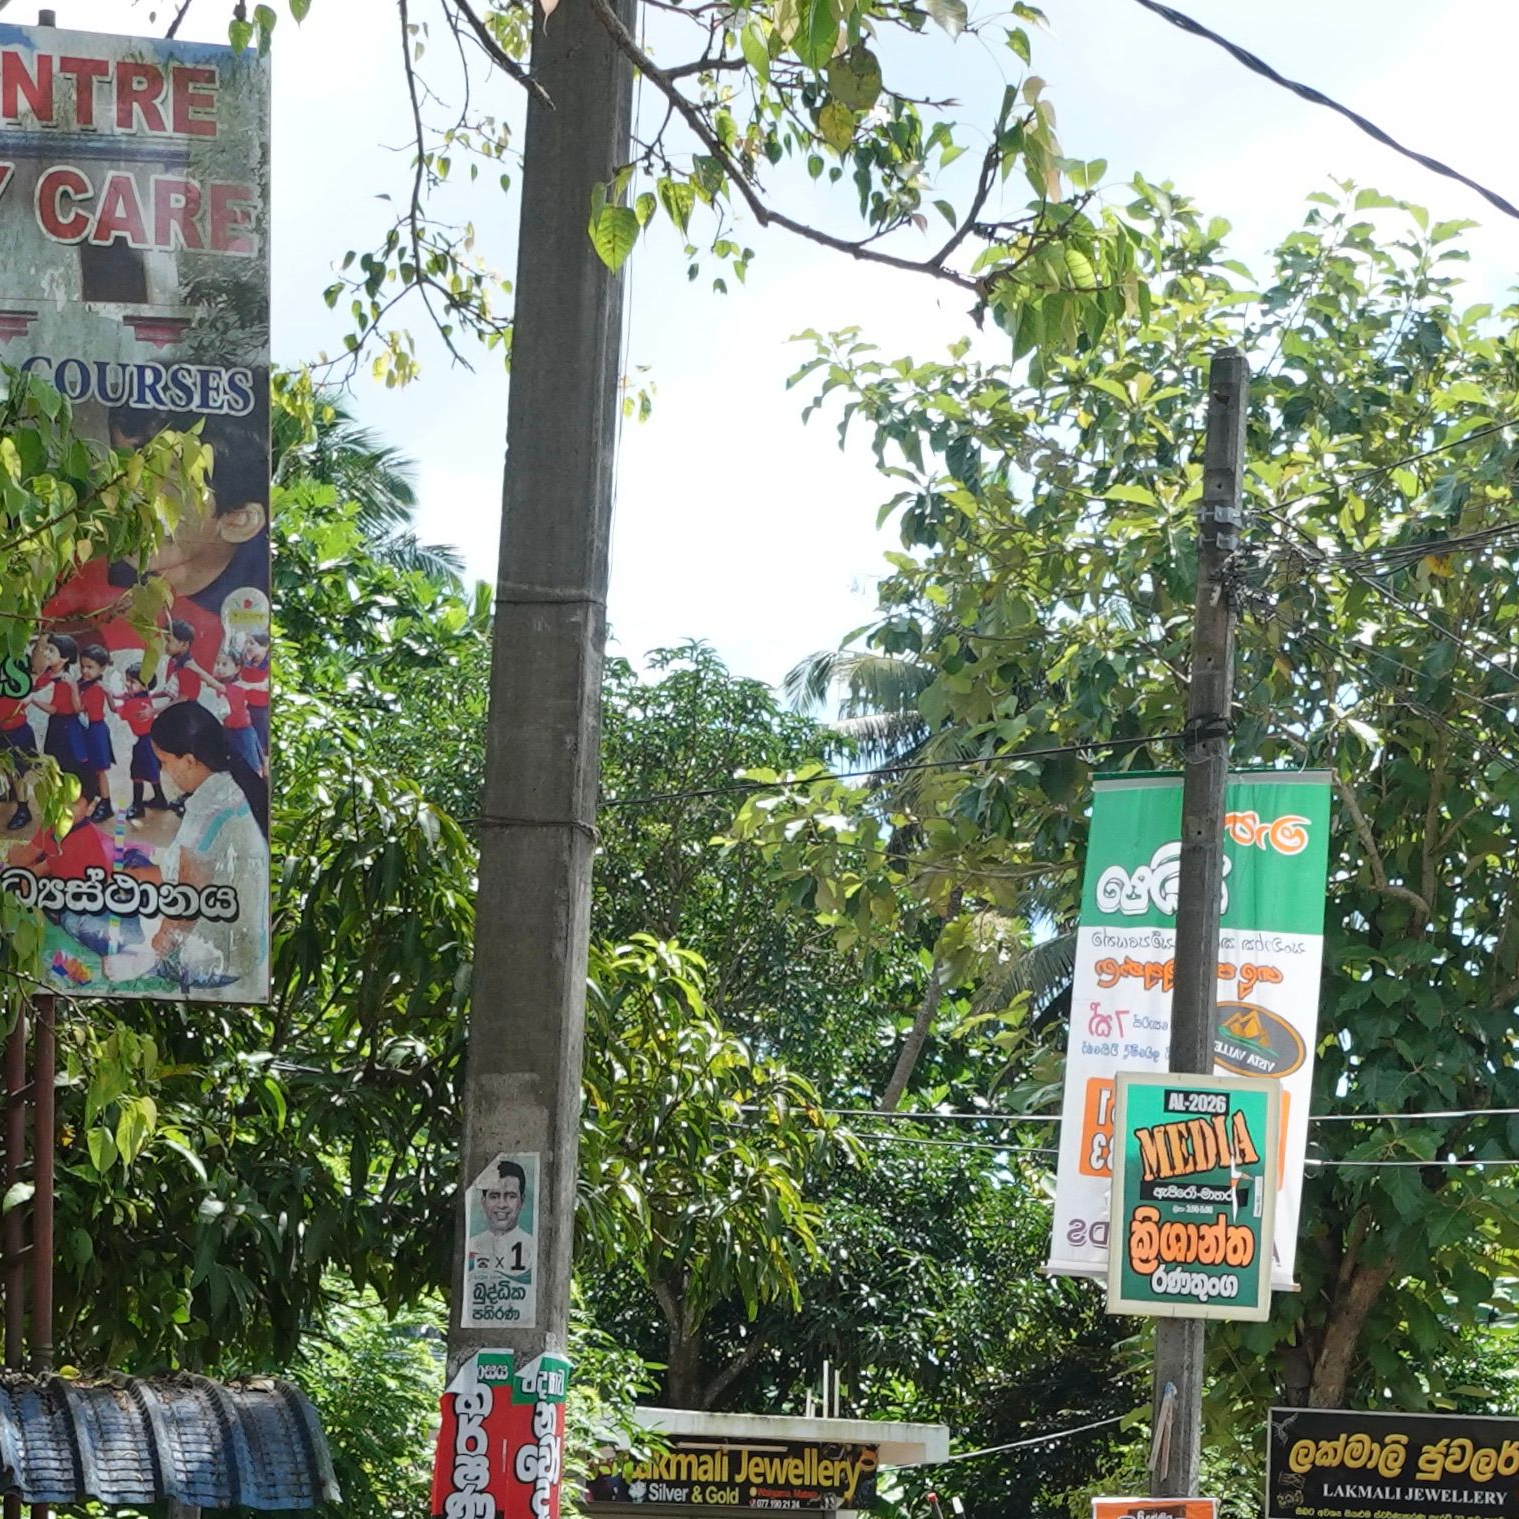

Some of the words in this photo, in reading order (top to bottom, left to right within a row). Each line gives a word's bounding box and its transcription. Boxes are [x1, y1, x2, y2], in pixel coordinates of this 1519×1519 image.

[34, 164, 262, 257] CARE
[21, 354, 256, 416] COURSES
[1168, 1092, 1226, 1113] AL-2026
[1135, 1111, 1259, 1181] MEDIA
[648, 1482, 690, 1503] Silver
[692, 1486, 703, 1504] &
[706, 1484, 739, 1505] Gold
[735, 1447, 860, 1501] Jewellery
[1322, 1483, 1401, 1501] LAKMALI
[1404, 1487, 1509, 1506] JEWELLERY
